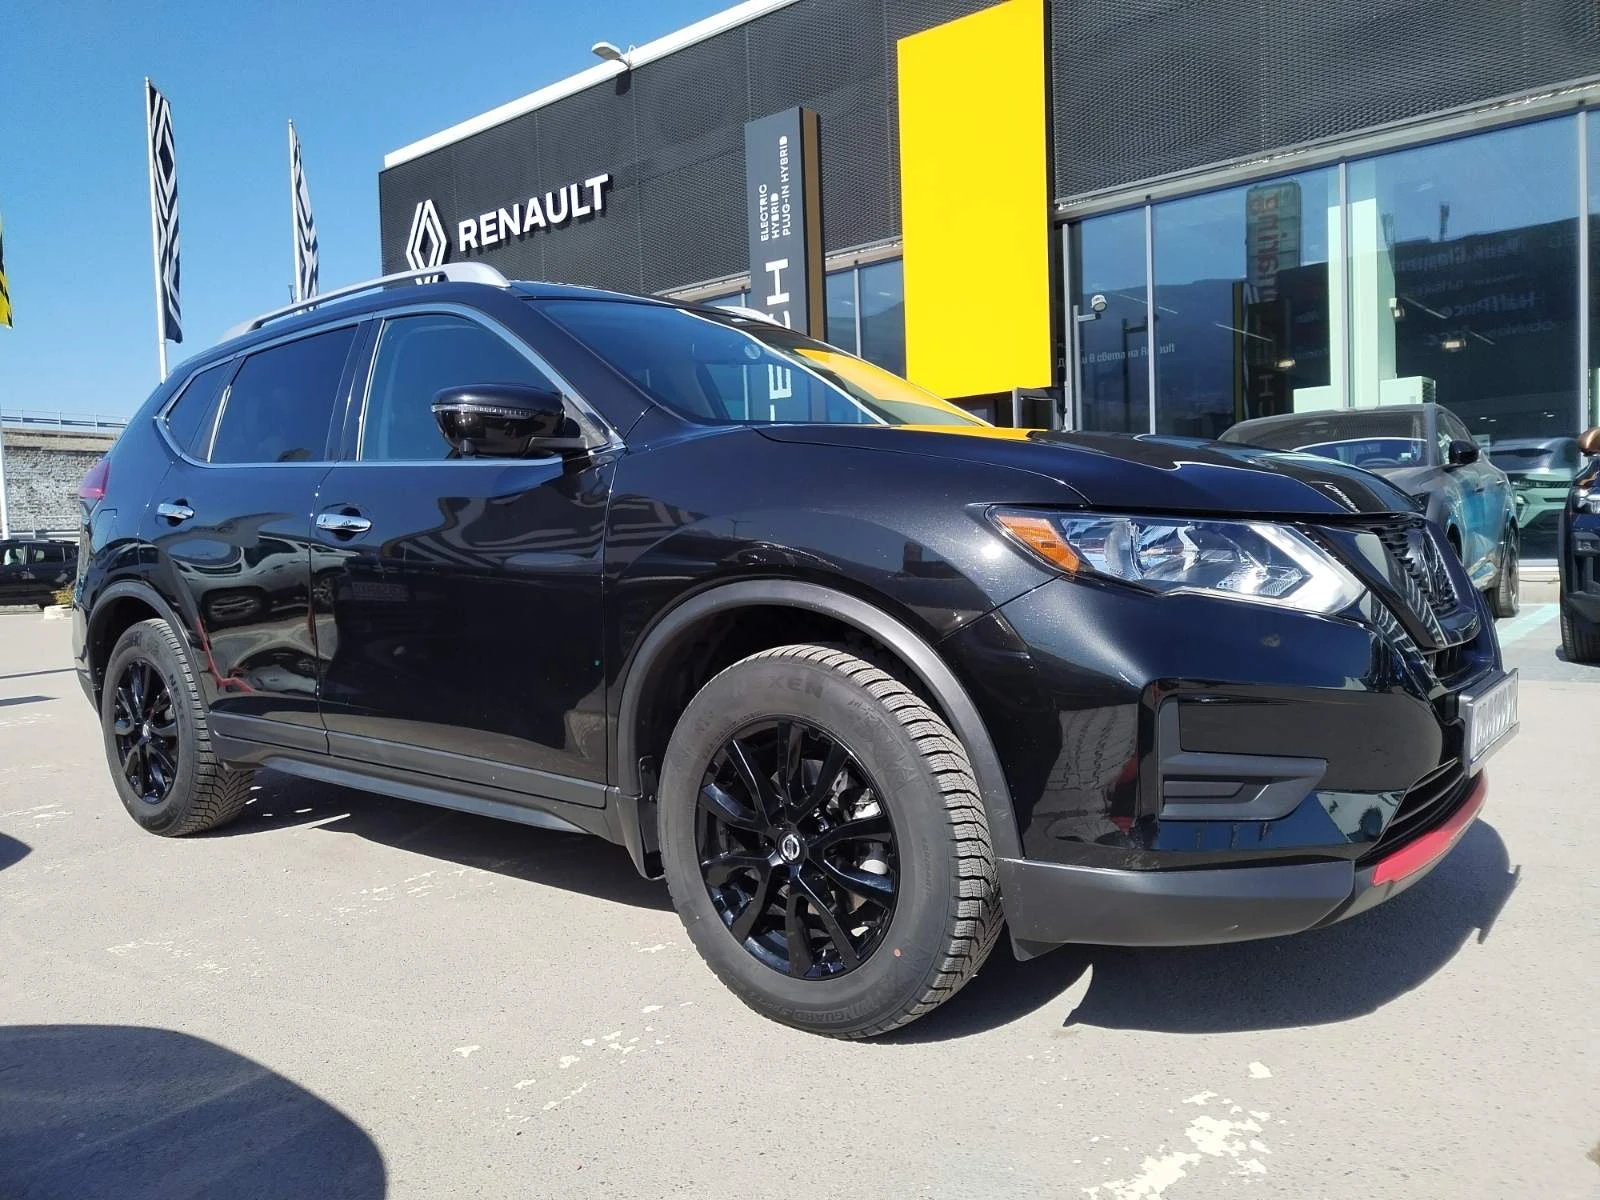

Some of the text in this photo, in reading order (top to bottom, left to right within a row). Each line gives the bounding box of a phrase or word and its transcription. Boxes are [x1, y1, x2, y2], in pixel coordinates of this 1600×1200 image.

[458, 173, 609, 252] RENAULT
[758, 183, 770, 242] ELECTRIC
[770, 192, 780, 239] HYBRID
[778, 135, 791, 236] PLUG-IN HYBRID
